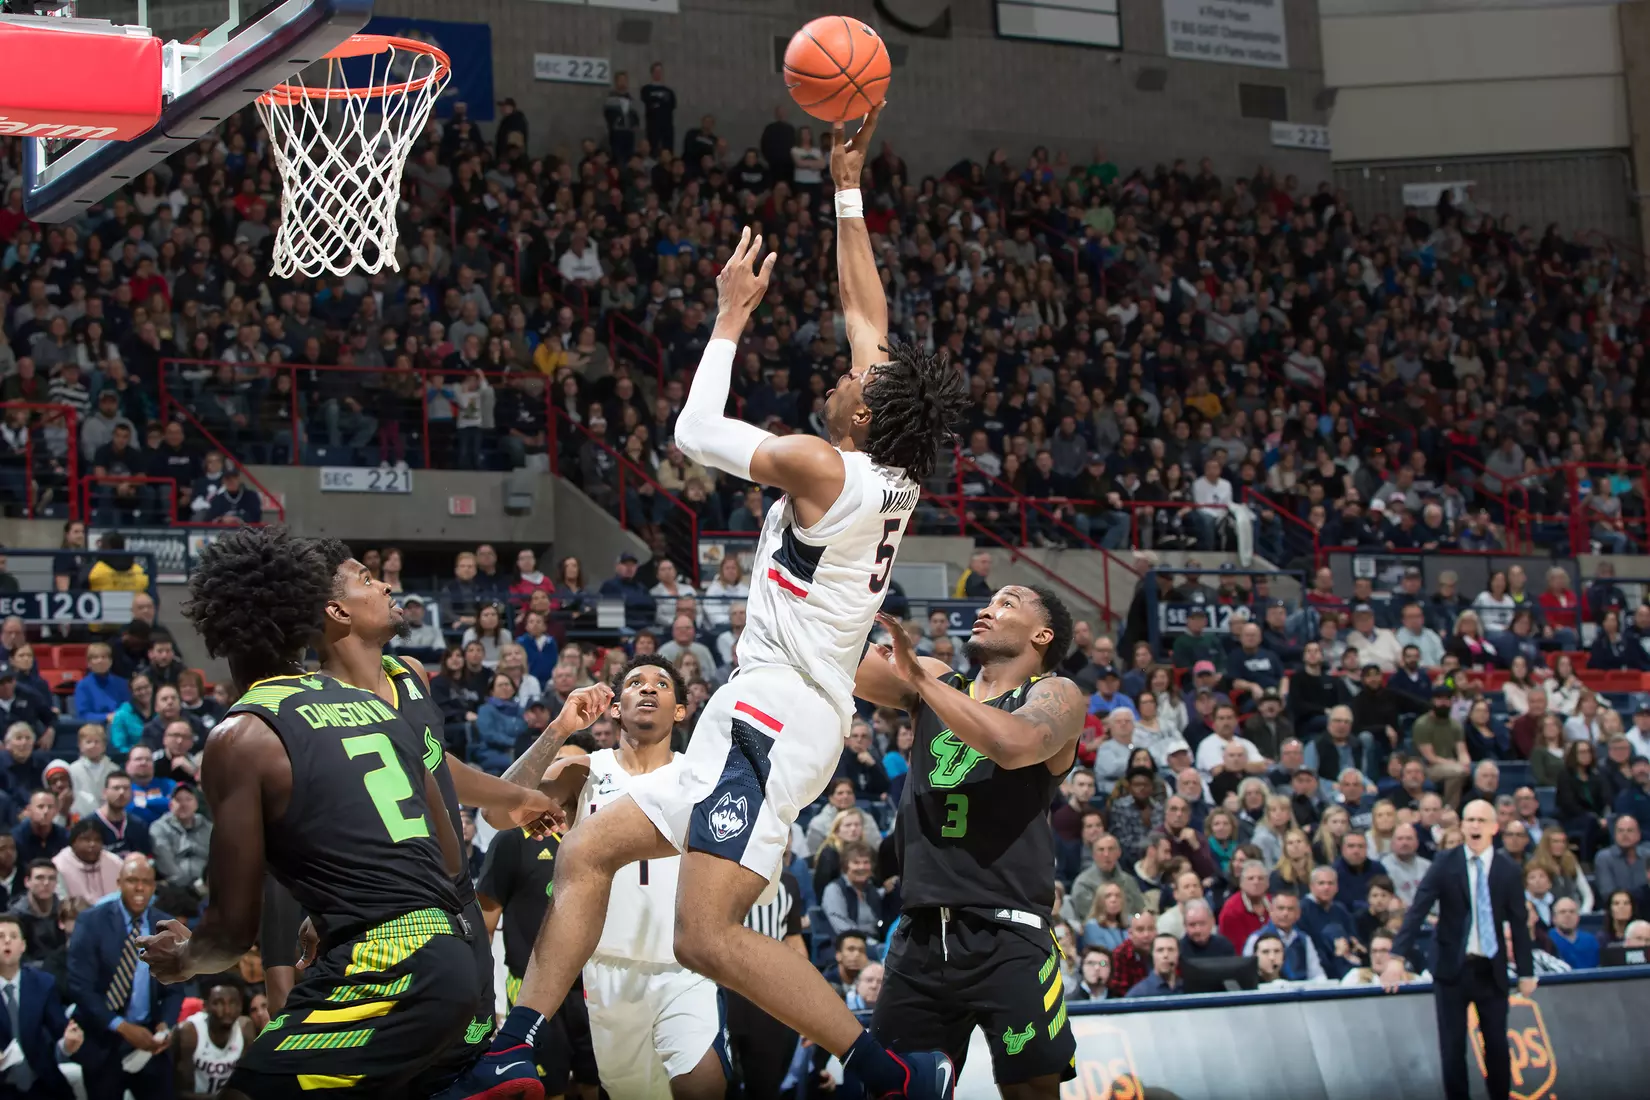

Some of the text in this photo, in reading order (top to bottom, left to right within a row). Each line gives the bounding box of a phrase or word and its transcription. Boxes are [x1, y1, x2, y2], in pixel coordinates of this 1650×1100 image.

[567, 60, 608, 79] 222
[0, 117, 118, 139] arm
[323, 469, 410, 492] SEC 221
[869, 518, 902, 594] 5
[0, 592, 101, 620] EC 120
[1168, 607, 1188, 624] SE
[295, 701, 382, 729] DAWSON
[341, 733, 429, 843] 2
[941, 794, 968, 838] 3
